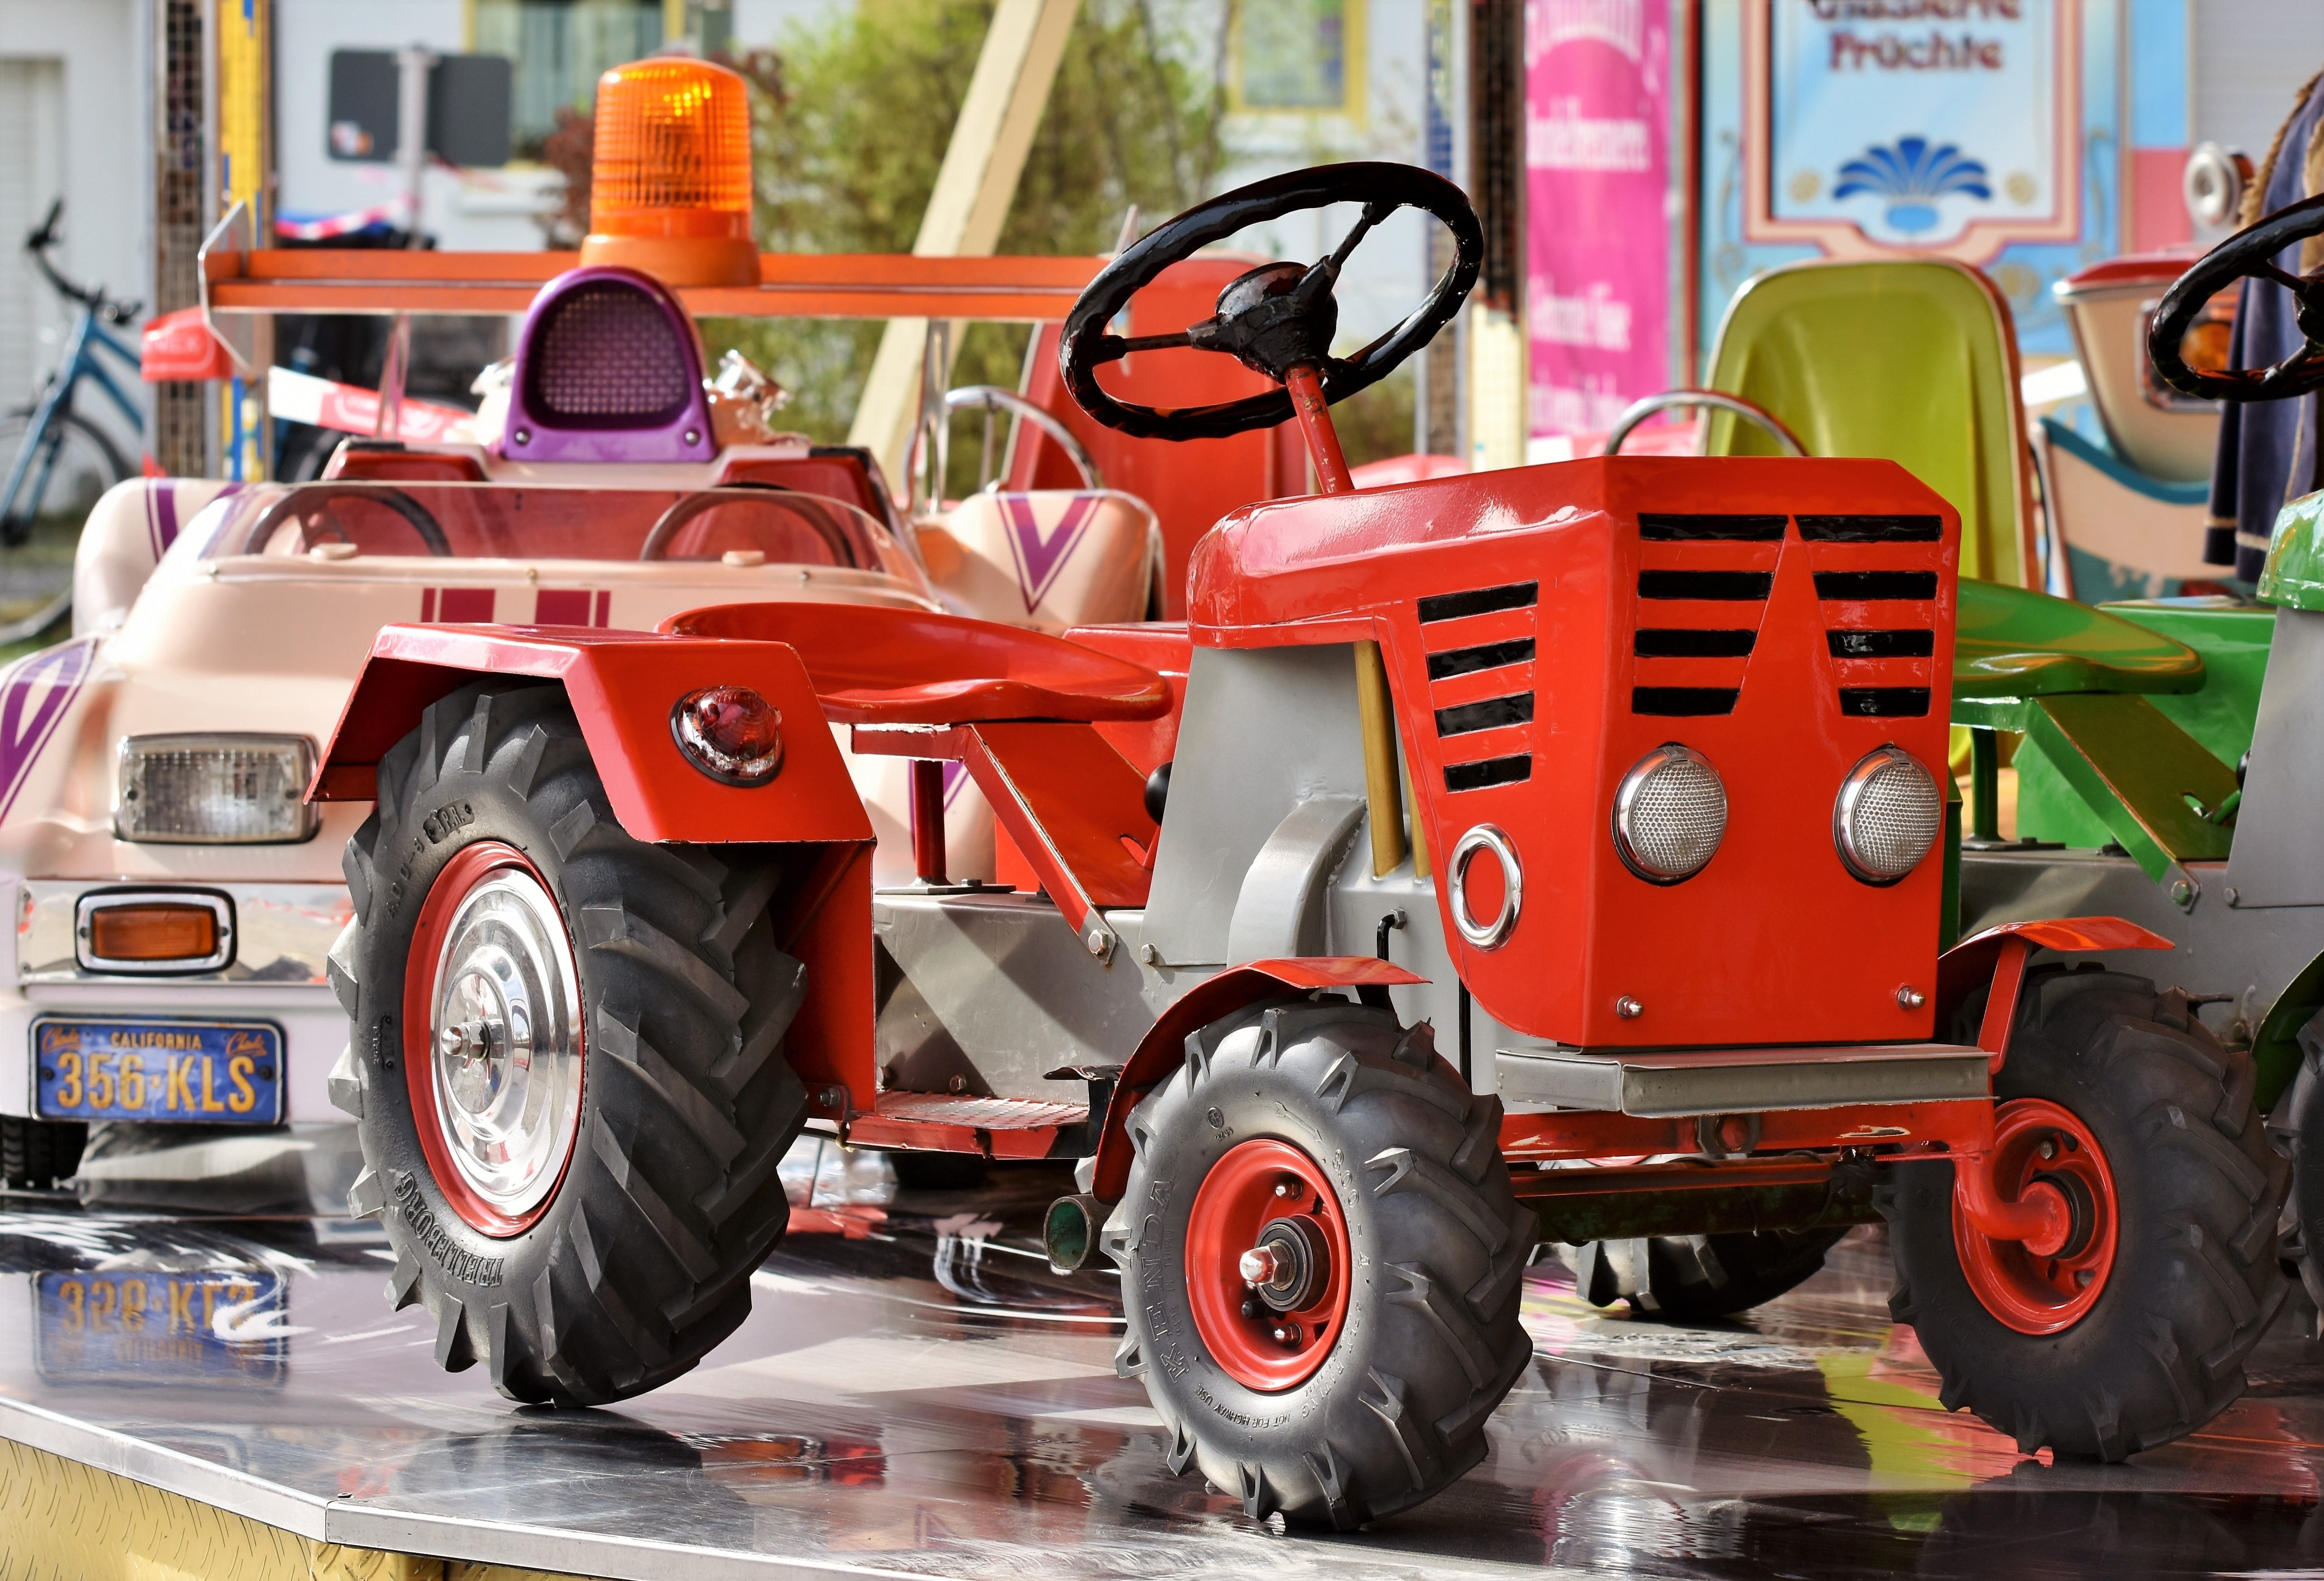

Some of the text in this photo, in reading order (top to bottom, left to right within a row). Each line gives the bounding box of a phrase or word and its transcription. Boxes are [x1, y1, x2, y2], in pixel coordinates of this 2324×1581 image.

[1829, 31, 2003, 71] Früchte
[111, 1032, 202, 1051] CALIFORNIA
[394, 1170, 504, 1287] TRELLEBORG
[1141, 1180, 1189, 1384] KENDA
[1301, 1361, 1345, 1420] RATING
[1251, 1416, 1270, 1429] FOR
[1272, 1411, 1291, 1427] NOT
